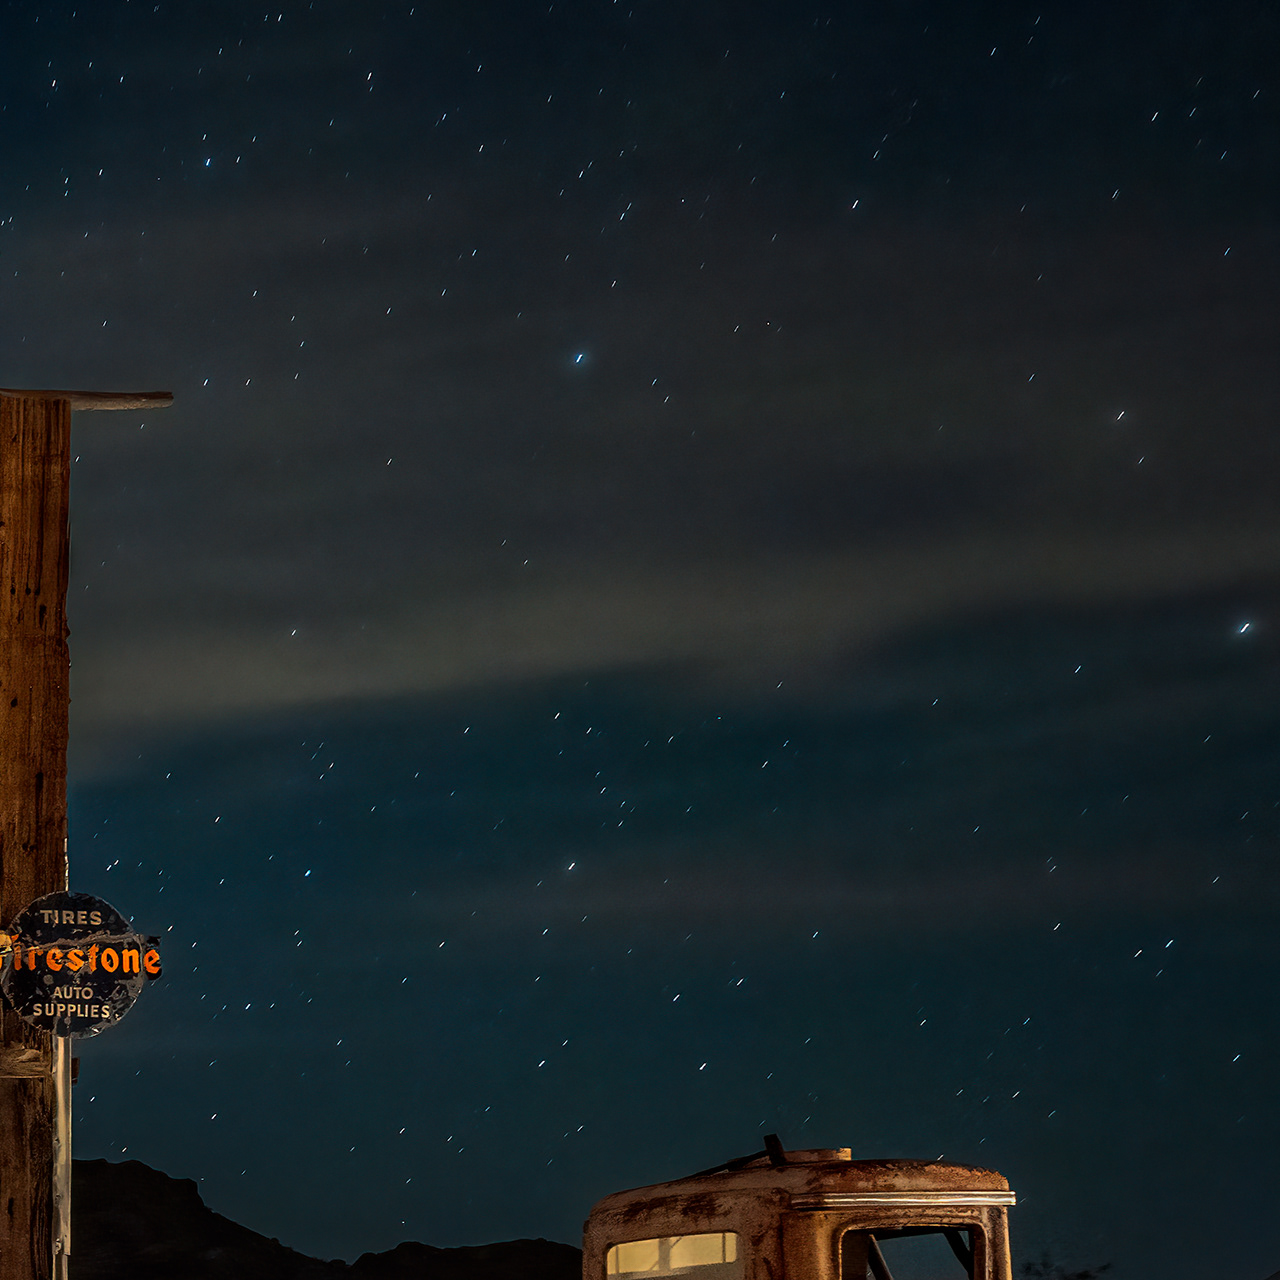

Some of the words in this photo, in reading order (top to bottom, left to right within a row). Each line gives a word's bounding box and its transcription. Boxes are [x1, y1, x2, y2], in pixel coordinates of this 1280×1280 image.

[40, 909, 102, 927] TIRES
[53, 987, 94, 1000] AUTO
[32, 1003, 111, 1019] SUPPLIES
